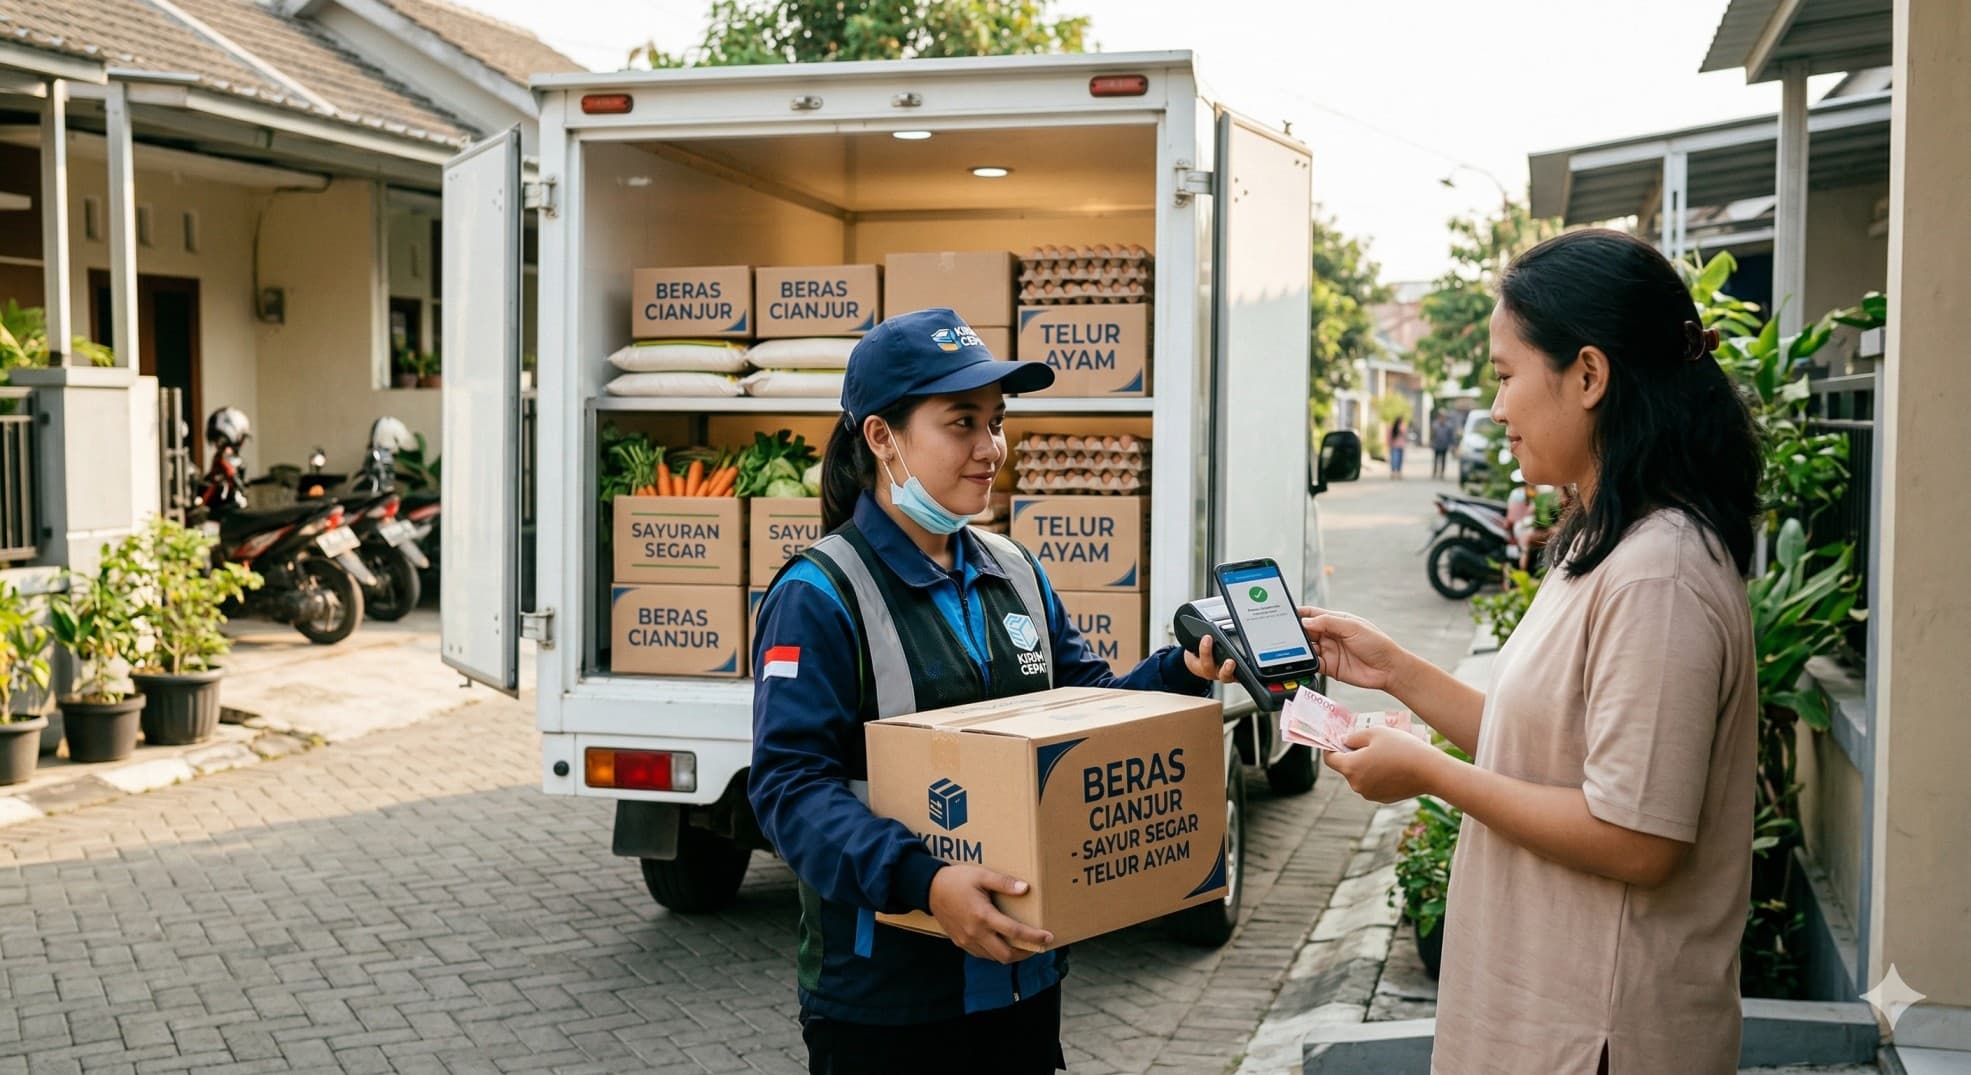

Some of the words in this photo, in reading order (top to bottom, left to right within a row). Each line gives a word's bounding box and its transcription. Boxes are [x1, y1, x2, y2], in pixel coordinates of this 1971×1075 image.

[655, 281, 721, 300] BERAS
[780, 280, 848, 299] BERAS
[644, 302, 732, 321] CIANJUR
[769, 301, 859, 320] CIANJUR
[1040, 323, 1120, 344] TELUR
[1045, 349, 1115, 371] AYAM
[631, 522, 720, 540] SAYURAN
[769, 524, 819, 541] SAYU
[1033, 516, 1115, 537] TELUR
[645, 542, 706, 559] SEGAR
[1039, 541, 1109, 563] AYAM
[638, 607, 708, 627] BERAS
[627, 628, 719, 649] CIANJUR
[1016, 651, 1045, 665] KIRIM
[1083, 748, 1186, 804] BERAS
[1089, 788, 1183, 831] CIANJUR
[1083, 828, 1140, 860] SAYUR
[1145, 813, 1199, 844] SEGAR
[1083, 854, 1139, 886] TELUR
[1143, 840, 1190, 870] AYAM
